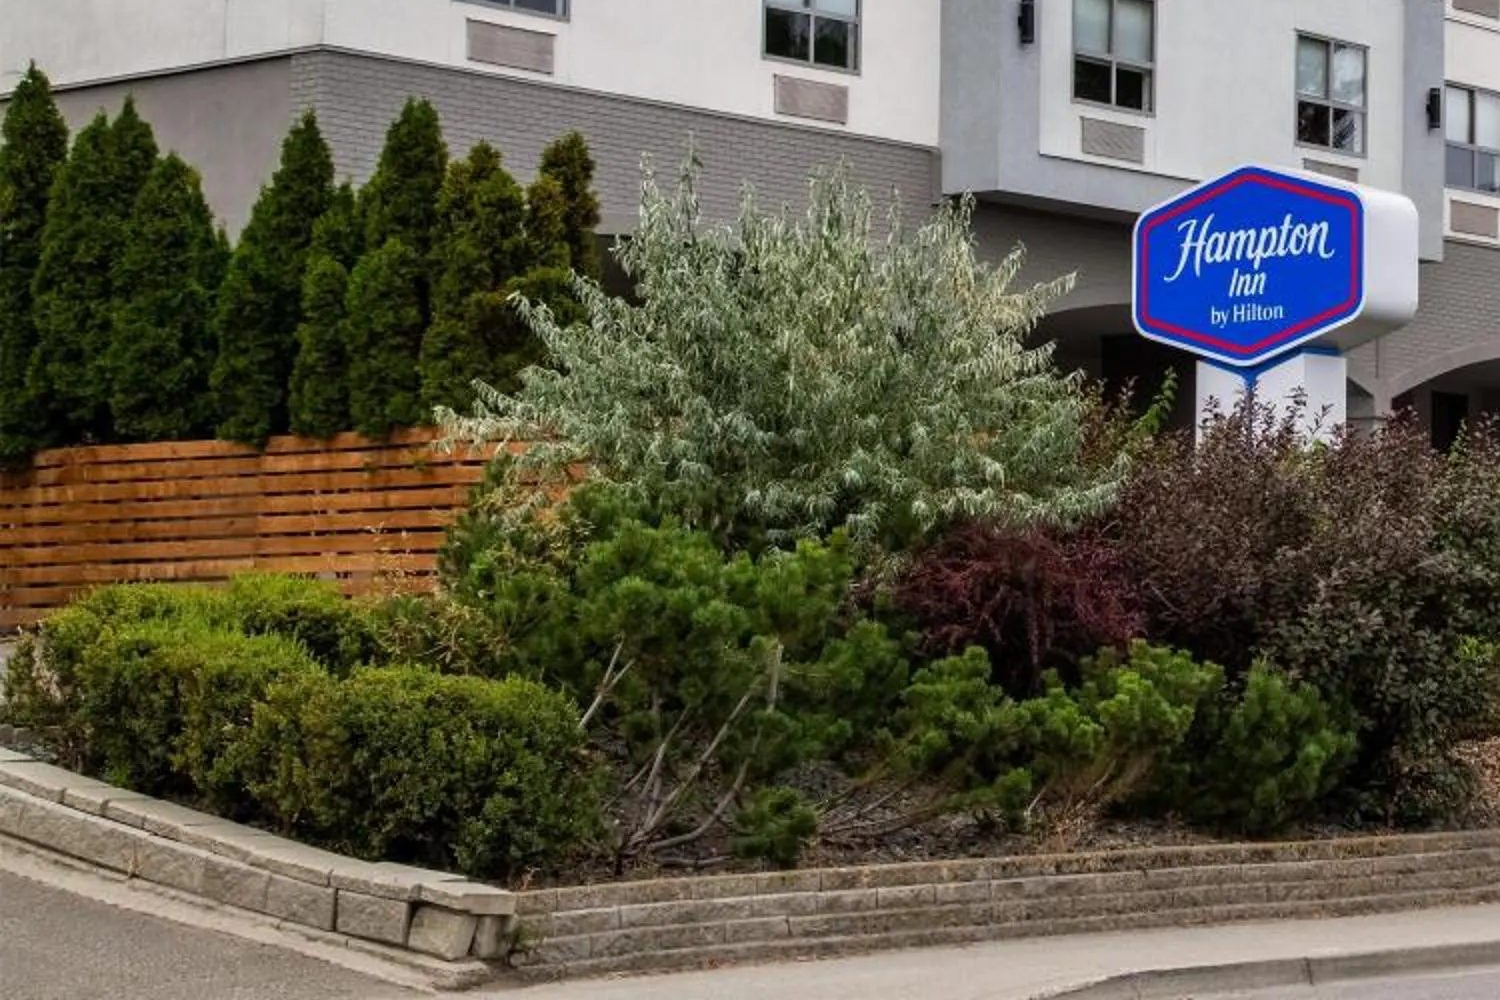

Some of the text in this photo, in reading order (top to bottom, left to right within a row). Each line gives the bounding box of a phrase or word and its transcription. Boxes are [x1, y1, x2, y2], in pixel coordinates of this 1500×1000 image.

[1163, 213, 1335, 283] Hampton
[1228, 268, 1267, 298] Inn
[1210, 303, 1284, 329] by Hilton
